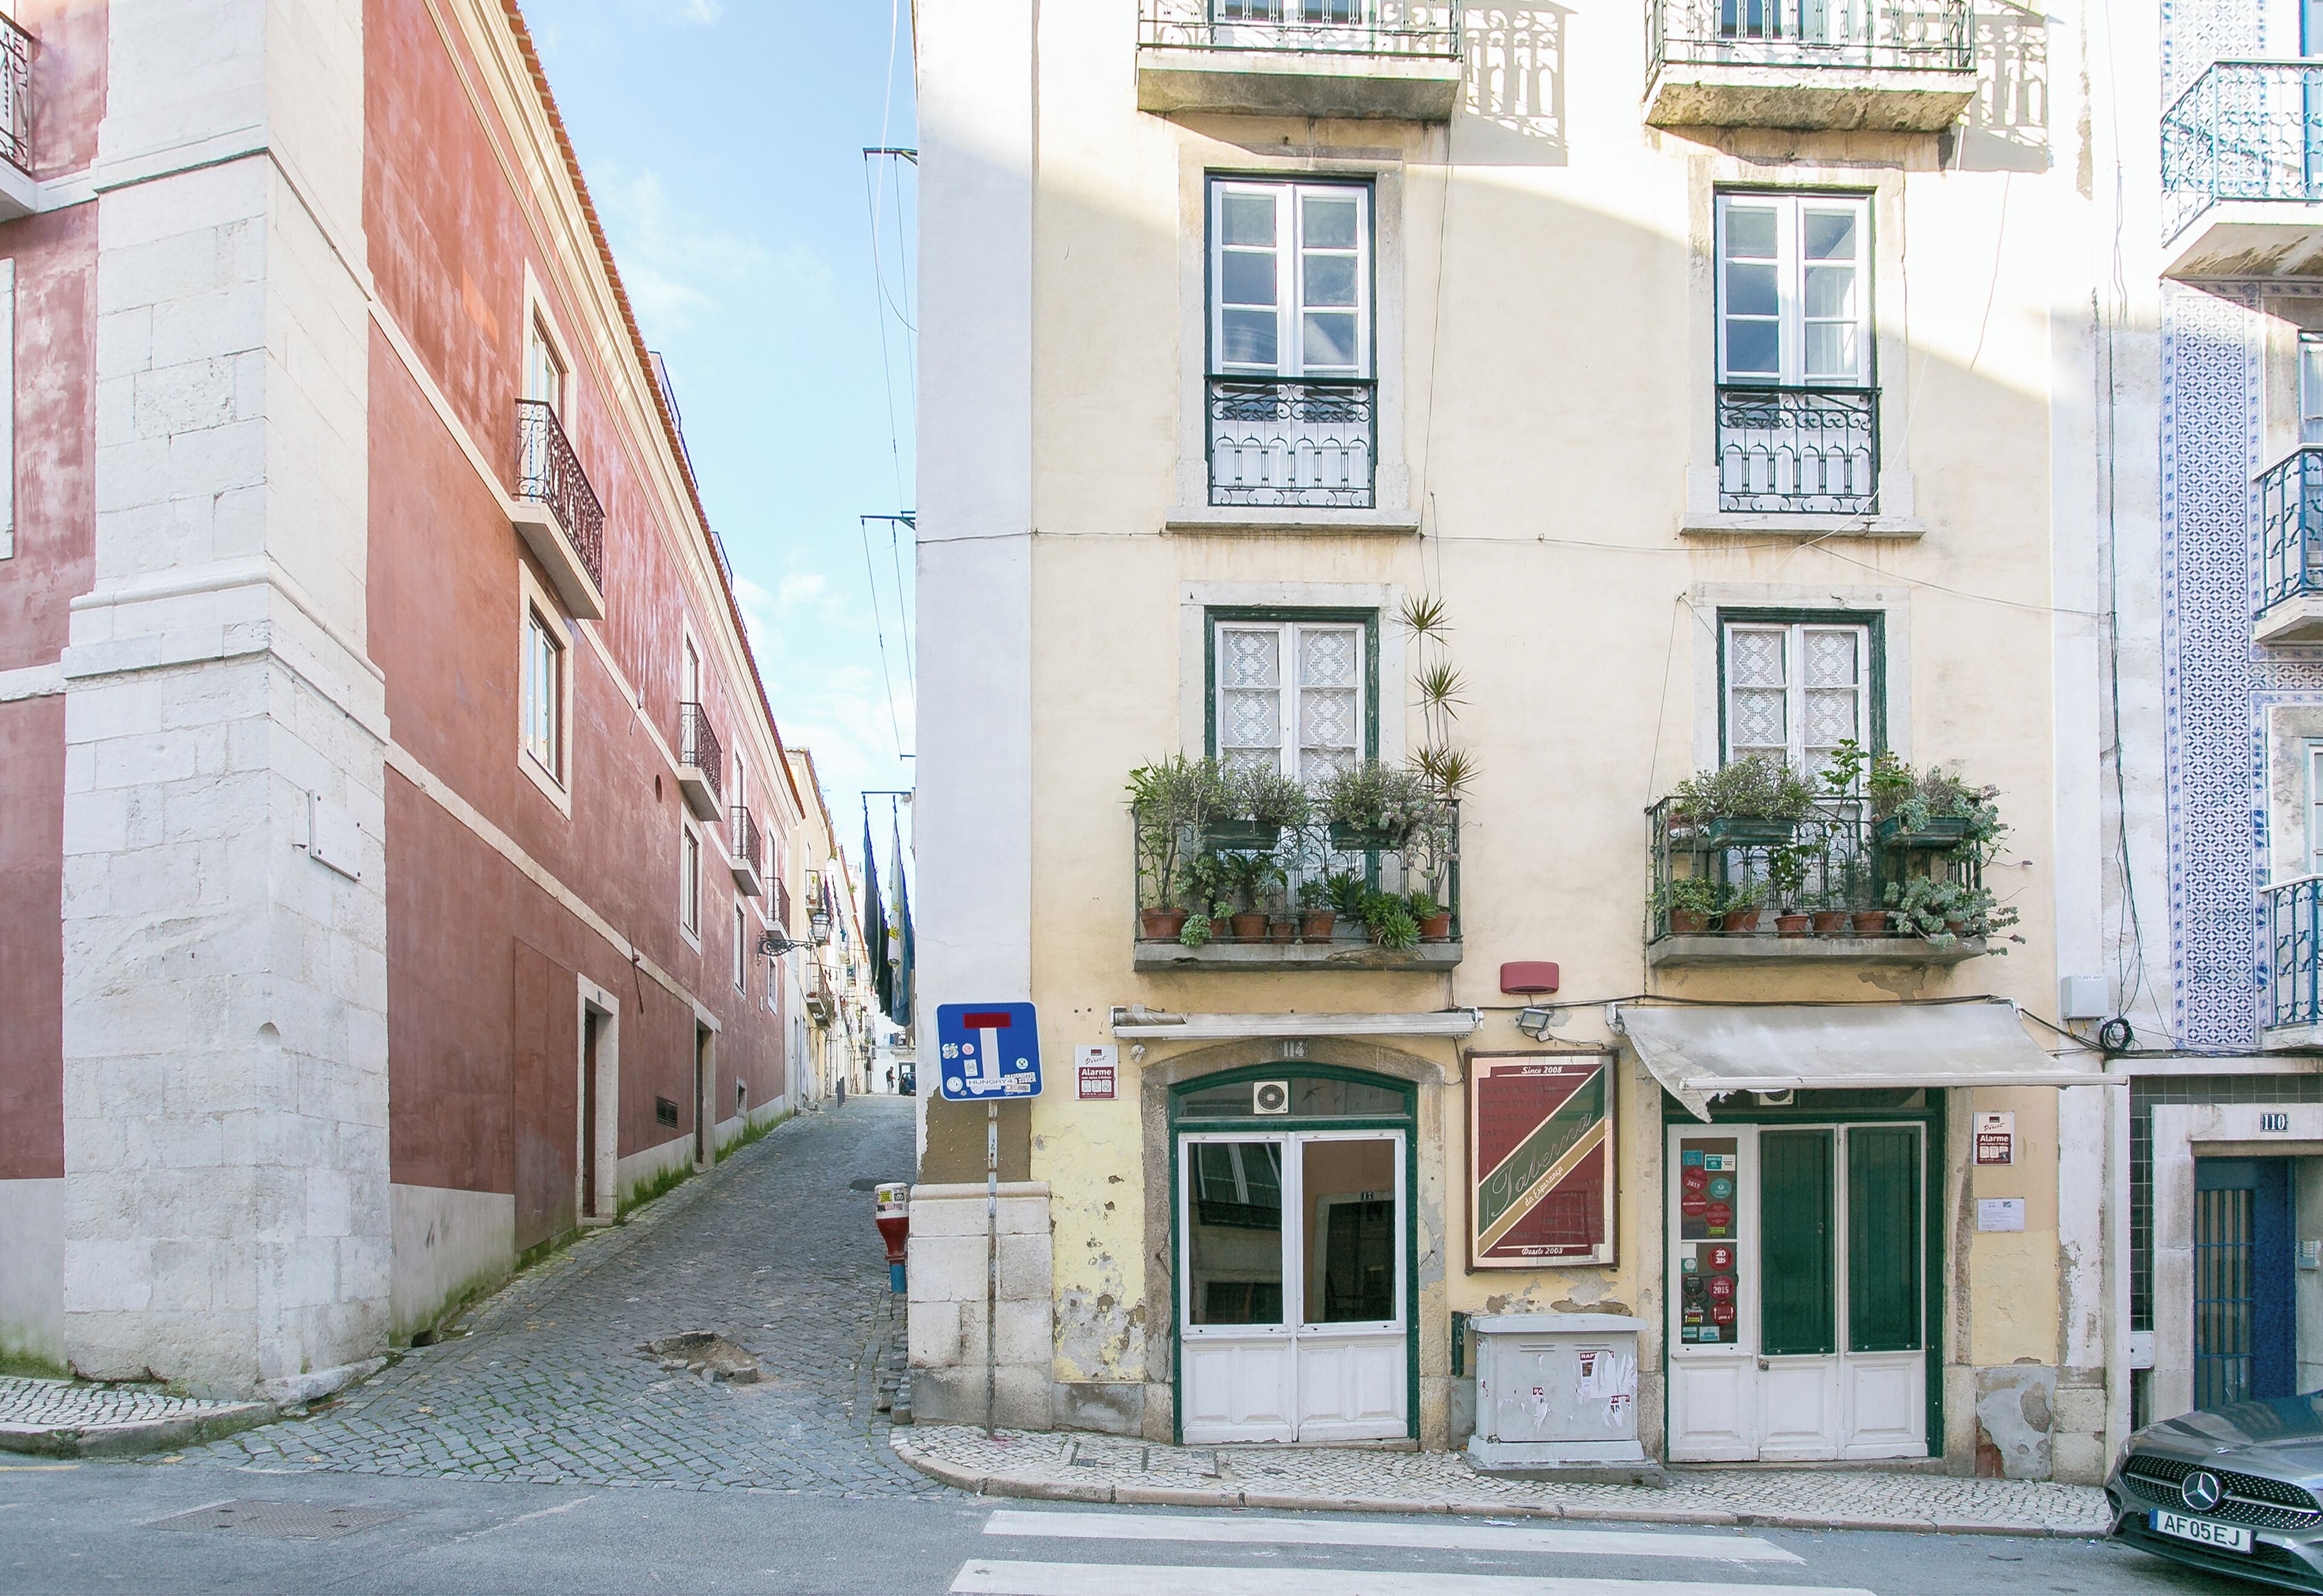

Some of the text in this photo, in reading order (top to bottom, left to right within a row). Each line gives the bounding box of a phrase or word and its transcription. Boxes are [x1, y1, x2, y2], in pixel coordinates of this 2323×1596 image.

[1283, 1041, 1305, 1057] 114
[2264, 1114, 2285, 1130] 110
[1491, 1113, 1592, 1217] Taberna
[1524, 1166, 1564, 1207] da Esperança
[2165, 1515, 2240, 1546] AF 05 EJ
